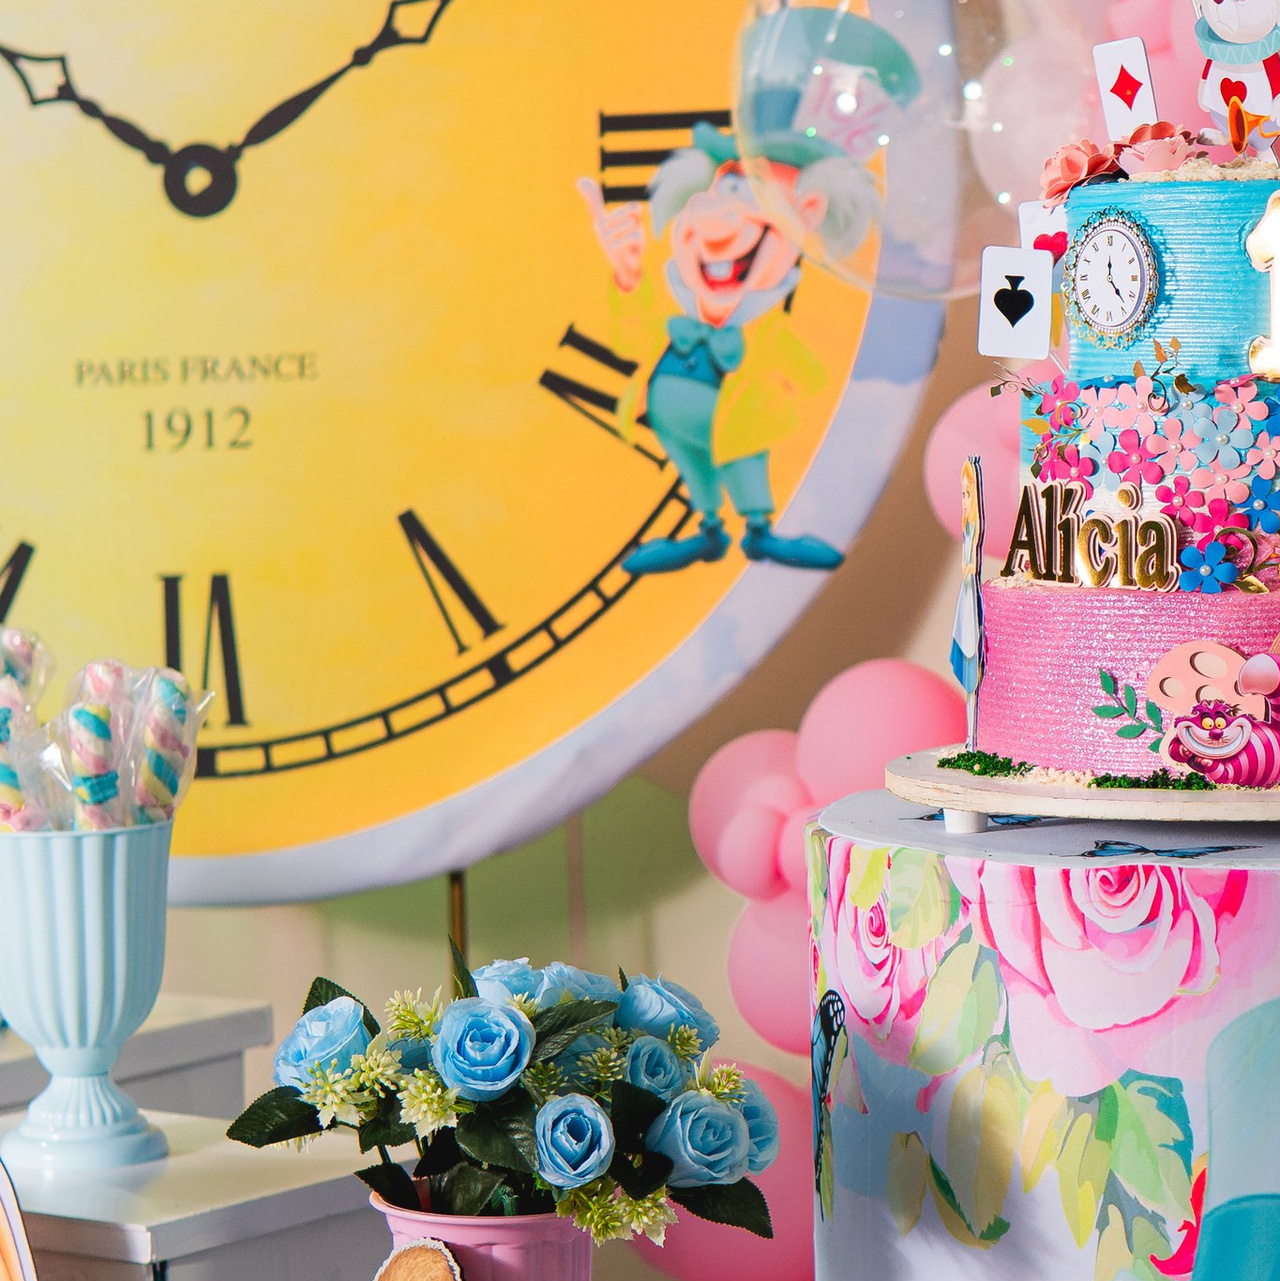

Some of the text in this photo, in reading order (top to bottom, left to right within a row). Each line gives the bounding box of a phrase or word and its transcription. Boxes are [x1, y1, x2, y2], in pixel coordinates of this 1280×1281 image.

[75, 351, 319, 388] PARIS FRANCE
[143, 405, 253, 453] 1912
